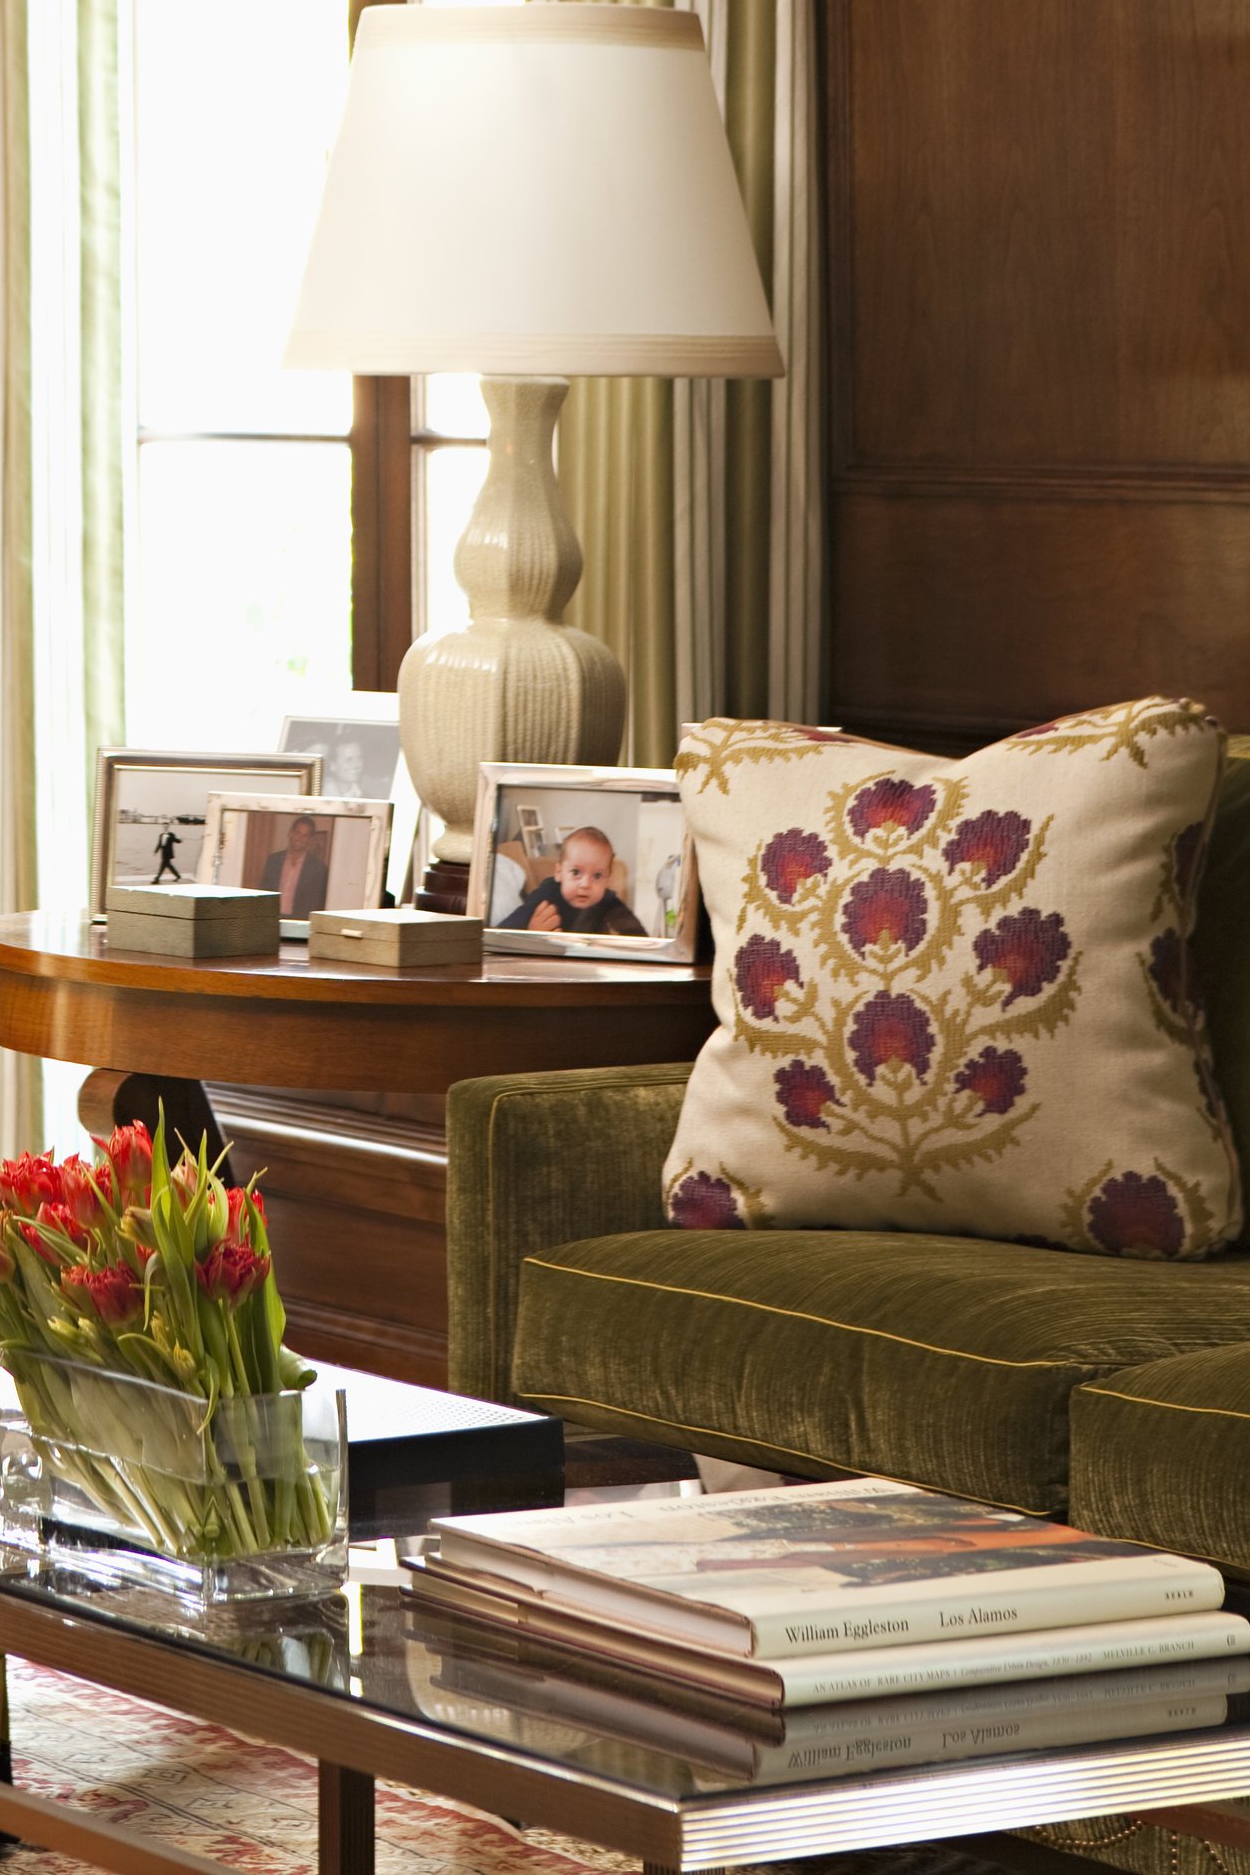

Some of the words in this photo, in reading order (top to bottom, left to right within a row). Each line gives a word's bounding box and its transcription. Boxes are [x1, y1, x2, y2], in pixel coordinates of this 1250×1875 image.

[784, 1623, 840, 1645] William
[843, 1618, 910, 1641] Eggleston
[939, 1610, 964, 1628] Los
[968, 1605, 1018, 1626] Alamos
[813, 1682, 827, 1694] AN
[828, 1679, 858, 1692] ATLAS
[859, 1678, 872, 1688] OF
[877, 1675, 901, 1687] RARE
[903, 1672, 925, 1685] CITY
[926, 1670, 950, 1683] MAPS
[960, 1665, 1002, 1679] Comparative
[1004, 1662, 1024, 1674] Urban
[1103, 1645, 1146, 1661] MELVILLE
[1159, 1640, 1195, 1654] BRANCH
